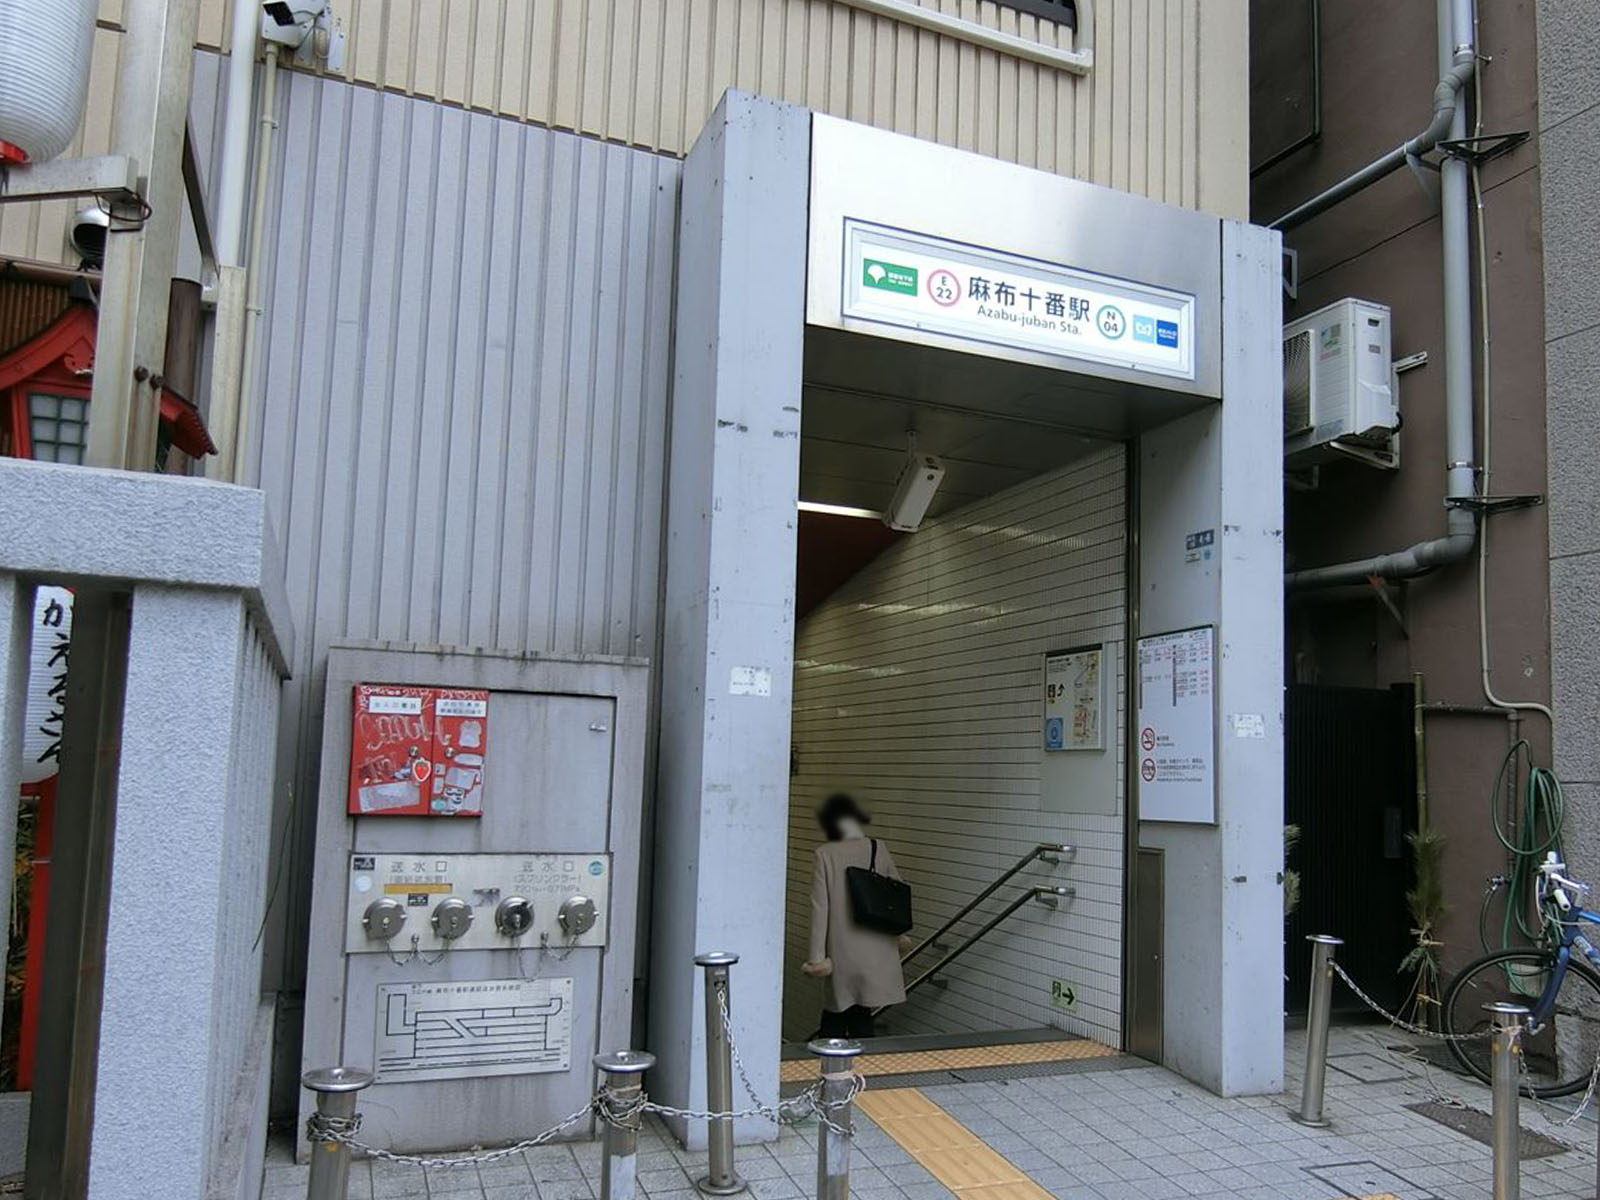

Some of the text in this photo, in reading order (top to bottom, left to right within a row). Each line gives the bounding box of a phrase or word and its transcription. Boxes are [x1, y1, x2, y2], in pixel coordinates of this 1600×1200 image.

[941, 275, 948, 287] E
[936, 286, 953, 300] 22
[968, 276, 1090, 322] 麻布十番駅
[977, 304, 1082, 336] Azabu-juban Sta.
[1106, 310, 1116, 321] N
[1103, 321, 1118, 333] 04
